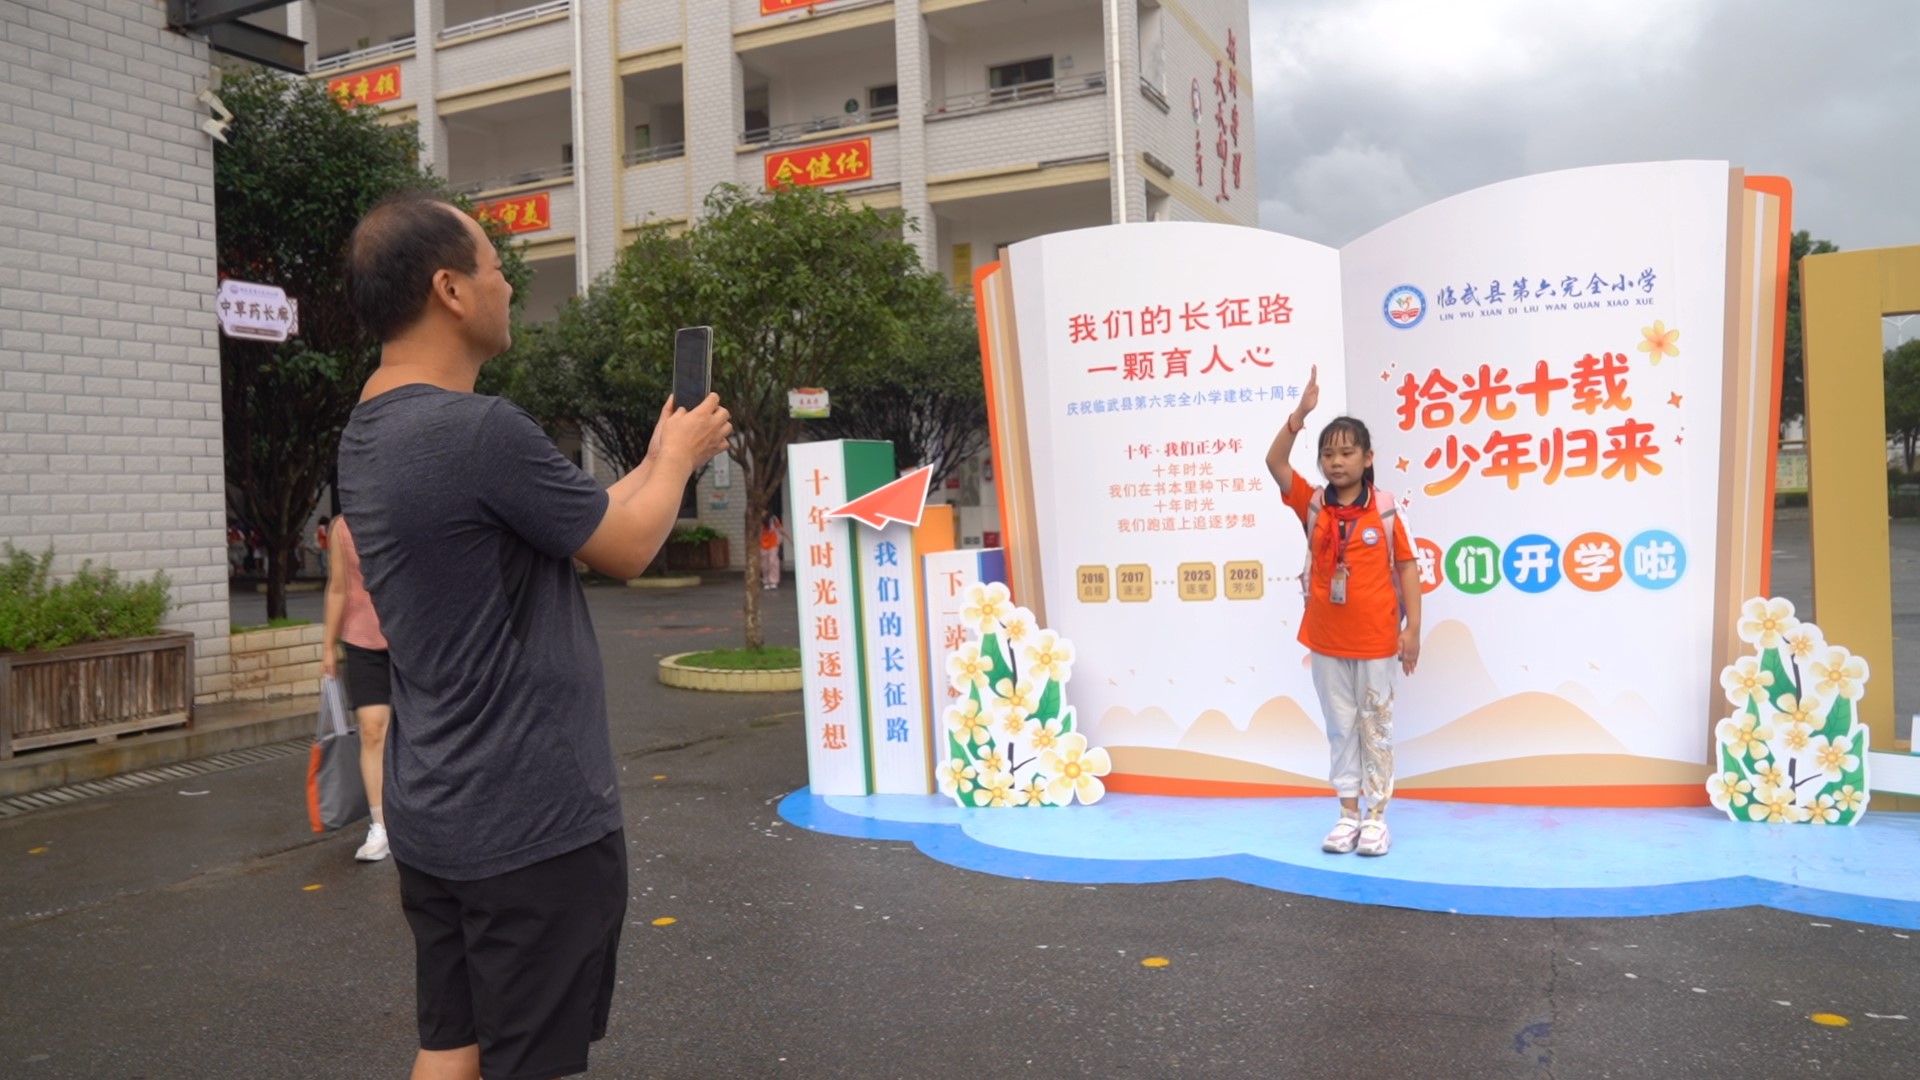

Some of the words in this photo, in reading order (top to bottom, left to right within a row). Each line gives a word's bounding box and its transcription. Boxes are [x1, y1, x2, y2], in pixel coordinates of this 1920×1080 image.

[1436, 267, 1657, 308] 临武县第六完全小学
[221, 297, 289, 324] 中草药长廊
[1068, 293, 1294, 344] 我们的长征路
[1439, 312, 1454, 322] LIN
[1460, 311, 1474, 319] WU
[1480, 308, 1502, 317] XIAN
[1508, 307, 1518, 315] DI
[1524, 305, 1539, 313] LIU
[1545, 303, 1567, 312] WAN
[1573, 301, 1600, 310] QUAN
[1607, 299, 1629, 308] XIAO
[1636, 297, 1654, 305] XUE
[1087, 344, 1274, 381] 一颗育人心
[1066, 385, 1300, 417] 庆祝临武县第六完全小学建校十周年
[1396, 352, 1633, 432] 拾光十载
[1152, 462, 1213, 478] 十年时光
[1423, 418, 1664, 497] 少年归来
[1109, 477, 1263, 498] 我们在书本里种下星光
[1153, 498, 1215, 513] 十年时光
[1117, 514, 1256, 533] 我们跑道上追逐梦想
[1082, 573, 1104, 584] 2016
[1121, 572, 1144, 583] 2017
[1184, 570, 1211, 582] 2025
[1230, 568, 1258, 580] 2026
[805, 469, 847, 750] 十年时光追逐梦想
[874, 542, 909, 744] 我们的长征路
